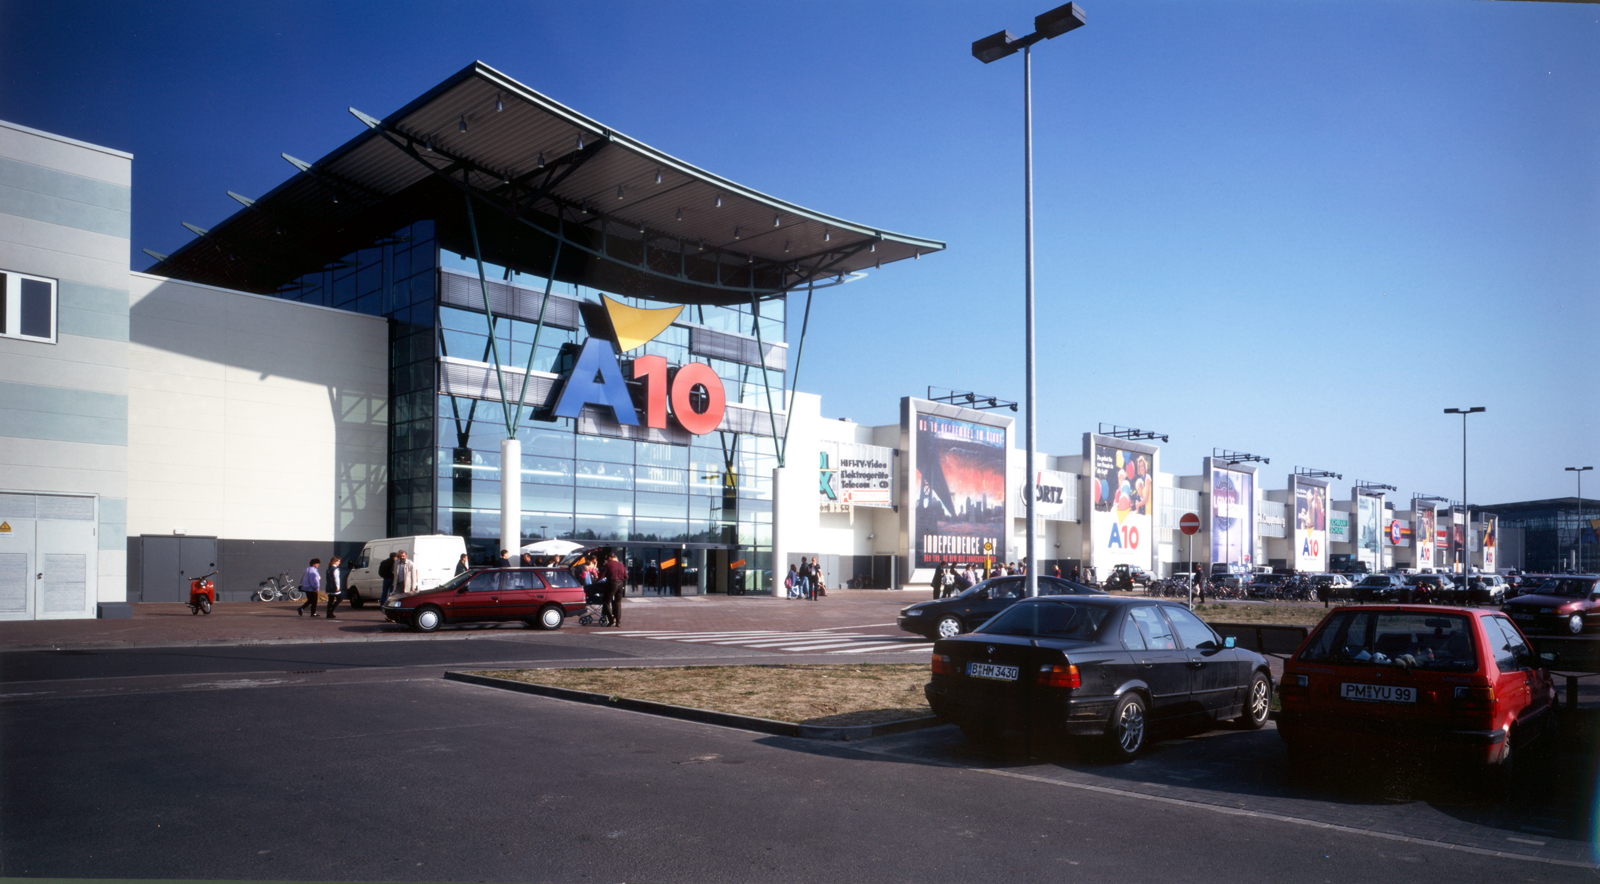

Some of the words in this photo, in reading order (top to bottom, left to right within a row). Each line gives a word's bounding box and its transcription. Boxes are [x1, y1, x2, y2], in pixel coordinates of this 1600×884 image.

[552, 336, 726, 435] A10
[841, 480, 870, 489] Telecom
[923, 534, 980, 555] INDEPENDENCE
[1107, 522, 1139, 550] A10
[1302, 537, 1319, 557] A10
[1420, 546, 1430, 561] A10
[971, 664, 978, 674] B
[995, 666, 1017, 679] 3430
[1346, 684, 1366, 697] PM
[1373, 686, 1391, 699] YU
[1395, 688, 1411, 701] 99
